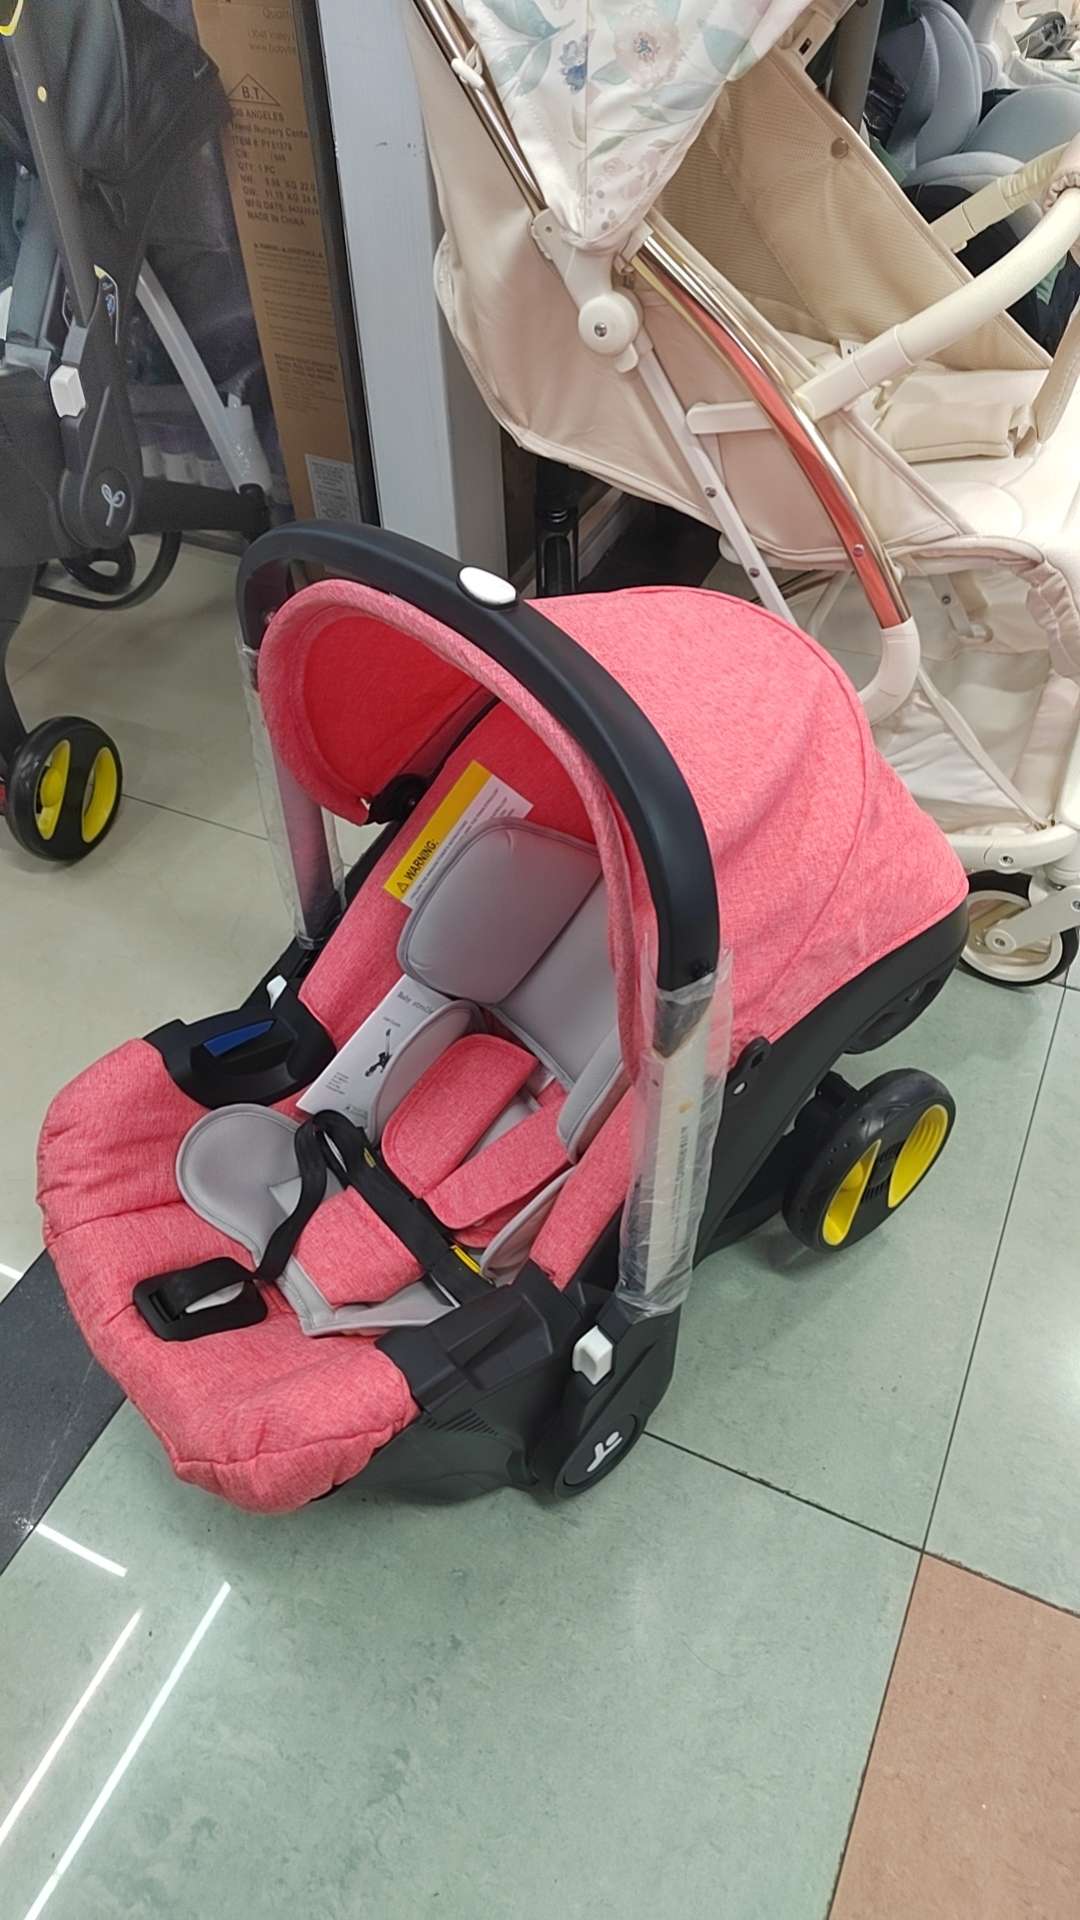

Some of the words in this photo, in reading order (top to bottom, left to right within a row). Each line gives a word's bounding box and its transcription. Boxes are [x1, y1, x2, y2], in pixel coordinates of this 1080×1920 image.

[241, 86, 264, 101] B.T.
[246, 109, 285, 122] ANGELES
[285, 128, 309, 139] Cente
[404, 838, 440, 881] WARNING:
